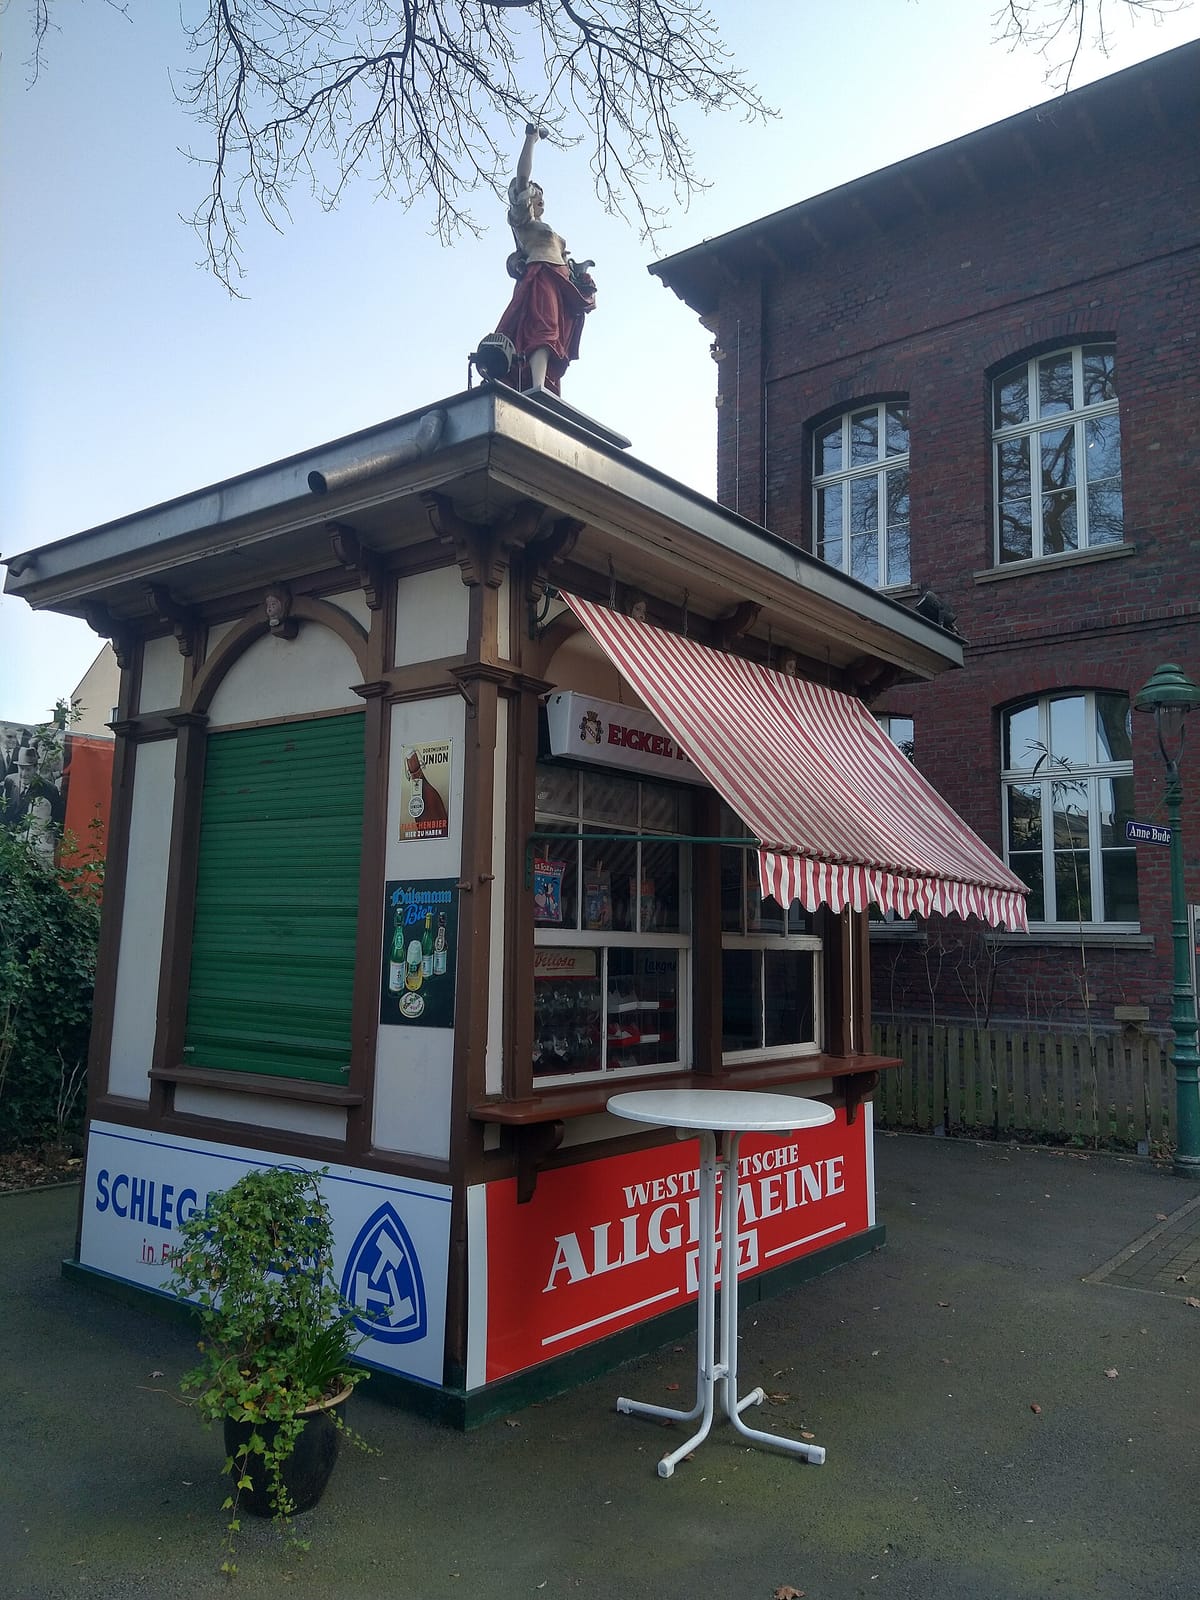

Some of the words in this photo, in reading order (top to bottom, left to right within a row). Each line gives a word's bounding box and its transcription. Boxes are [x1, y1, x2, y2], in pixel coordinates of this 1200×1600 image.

[423, 745, 449, 754] DORTMUNDER
[607, 723, 673, 758] EICKEL
[423, 752, 449, 765] UNION
[1129, 825, 1151, 839] Anne
[1152, 828, 1171, 843] Bude
[404, 903, 436, 926] Bier
